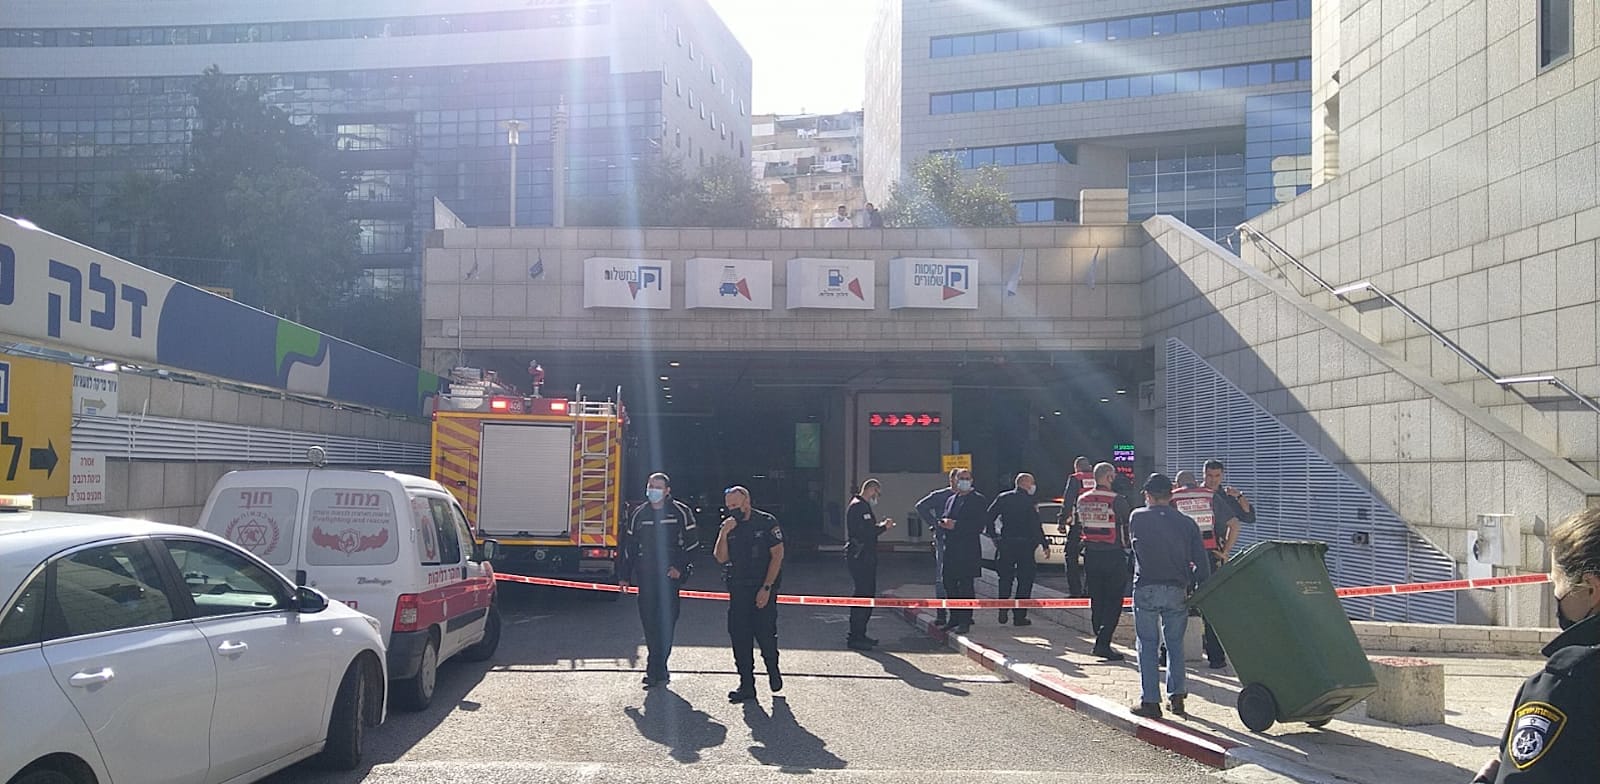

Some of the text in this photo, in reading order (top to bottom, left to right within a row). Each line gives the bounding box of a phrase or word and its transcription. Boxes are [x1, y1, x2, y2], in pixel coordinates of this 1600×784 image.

[914, 263, 944, 275] מקומות
[914, 275, 944, 286] שמורים
[48, 259, 148, 339] דלק
[240, 491, 273, 509] חוף
[335, 492, 380, 506] מחוז
